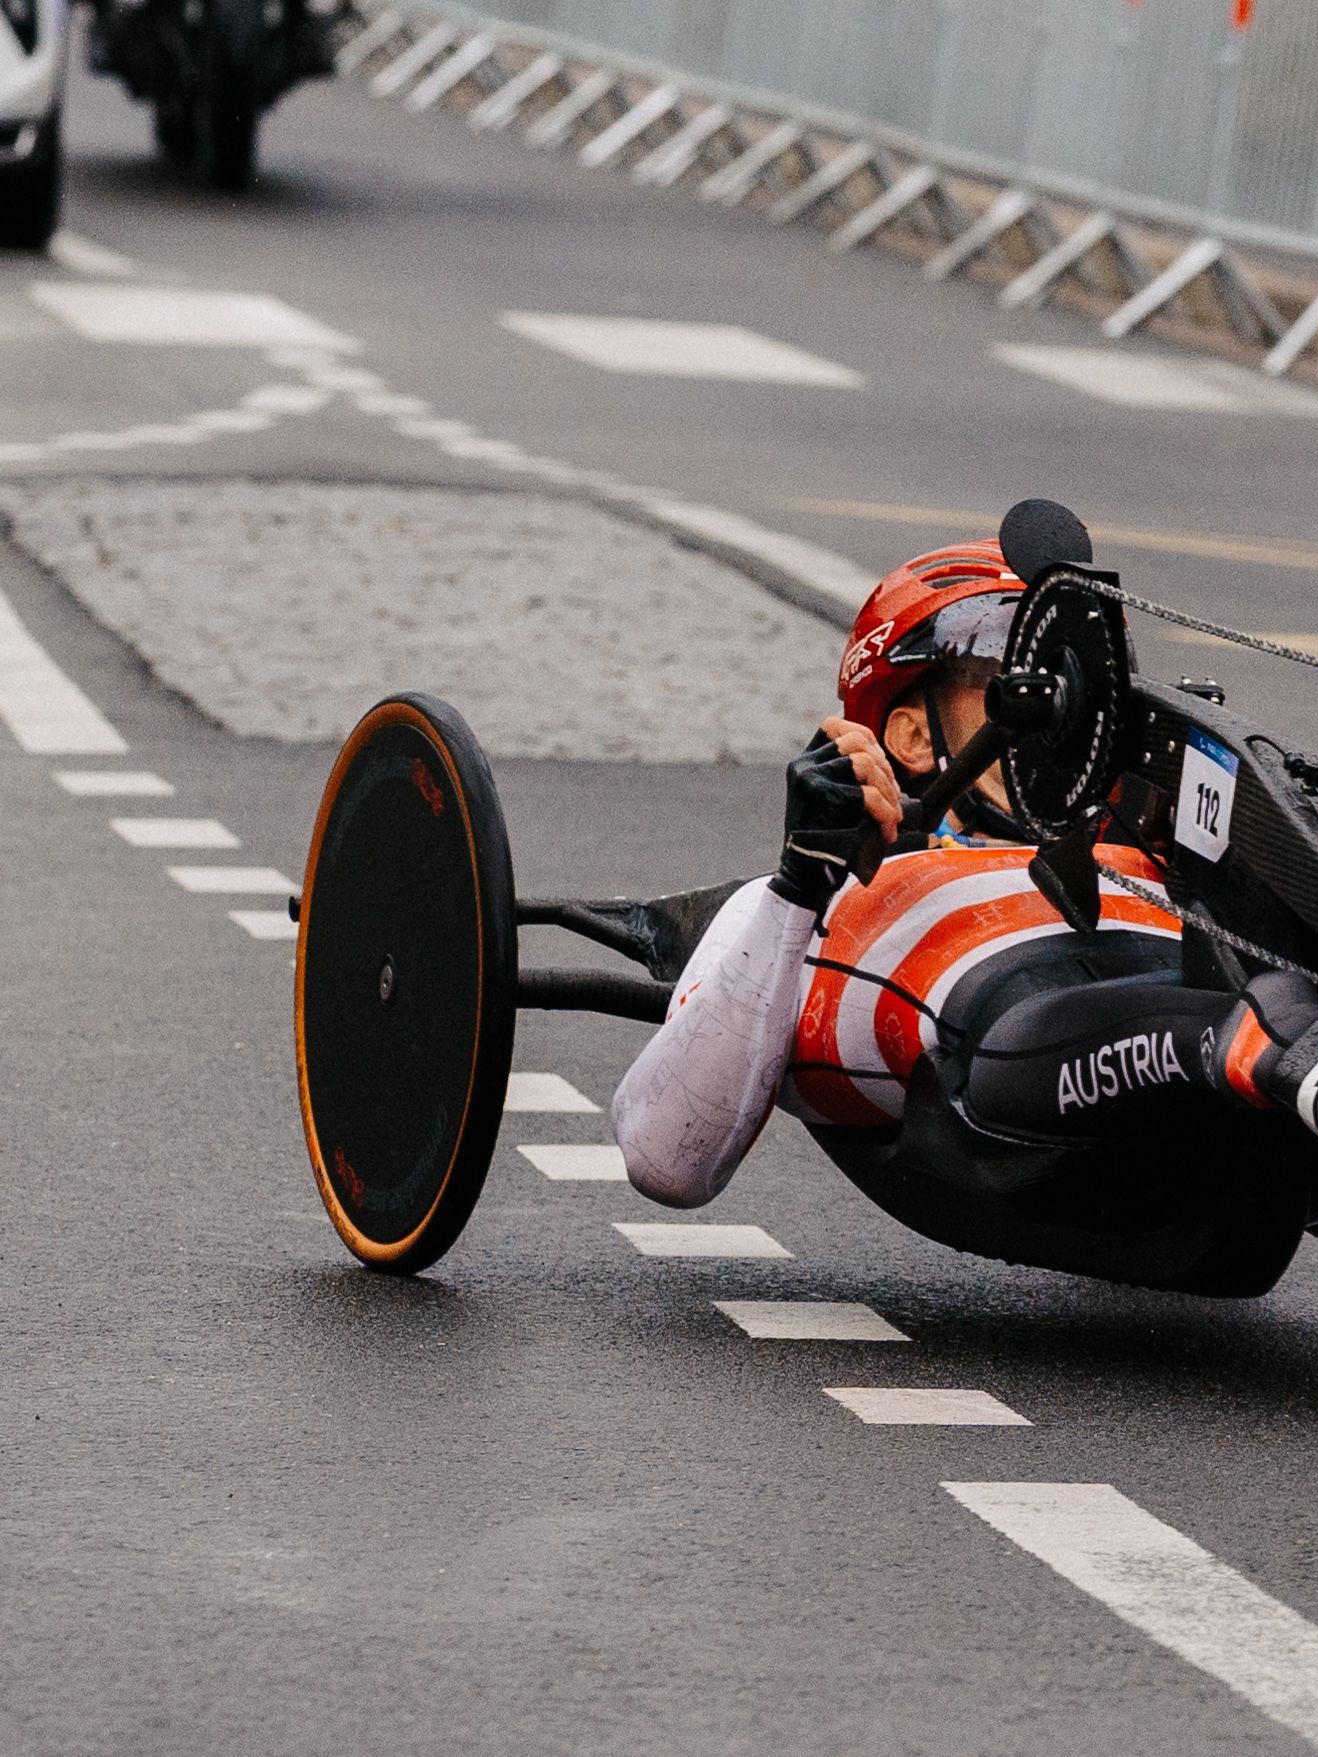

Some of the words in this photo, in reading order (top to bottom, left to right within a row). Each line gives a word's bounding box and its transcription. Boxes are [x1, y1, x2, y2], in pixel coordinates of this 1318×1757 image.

[1024, 604, 1057, 673] OTOR
[1196, 783, 1220, 838] 112
[1057, 1031, 1189, 1115] AUSTRIA
